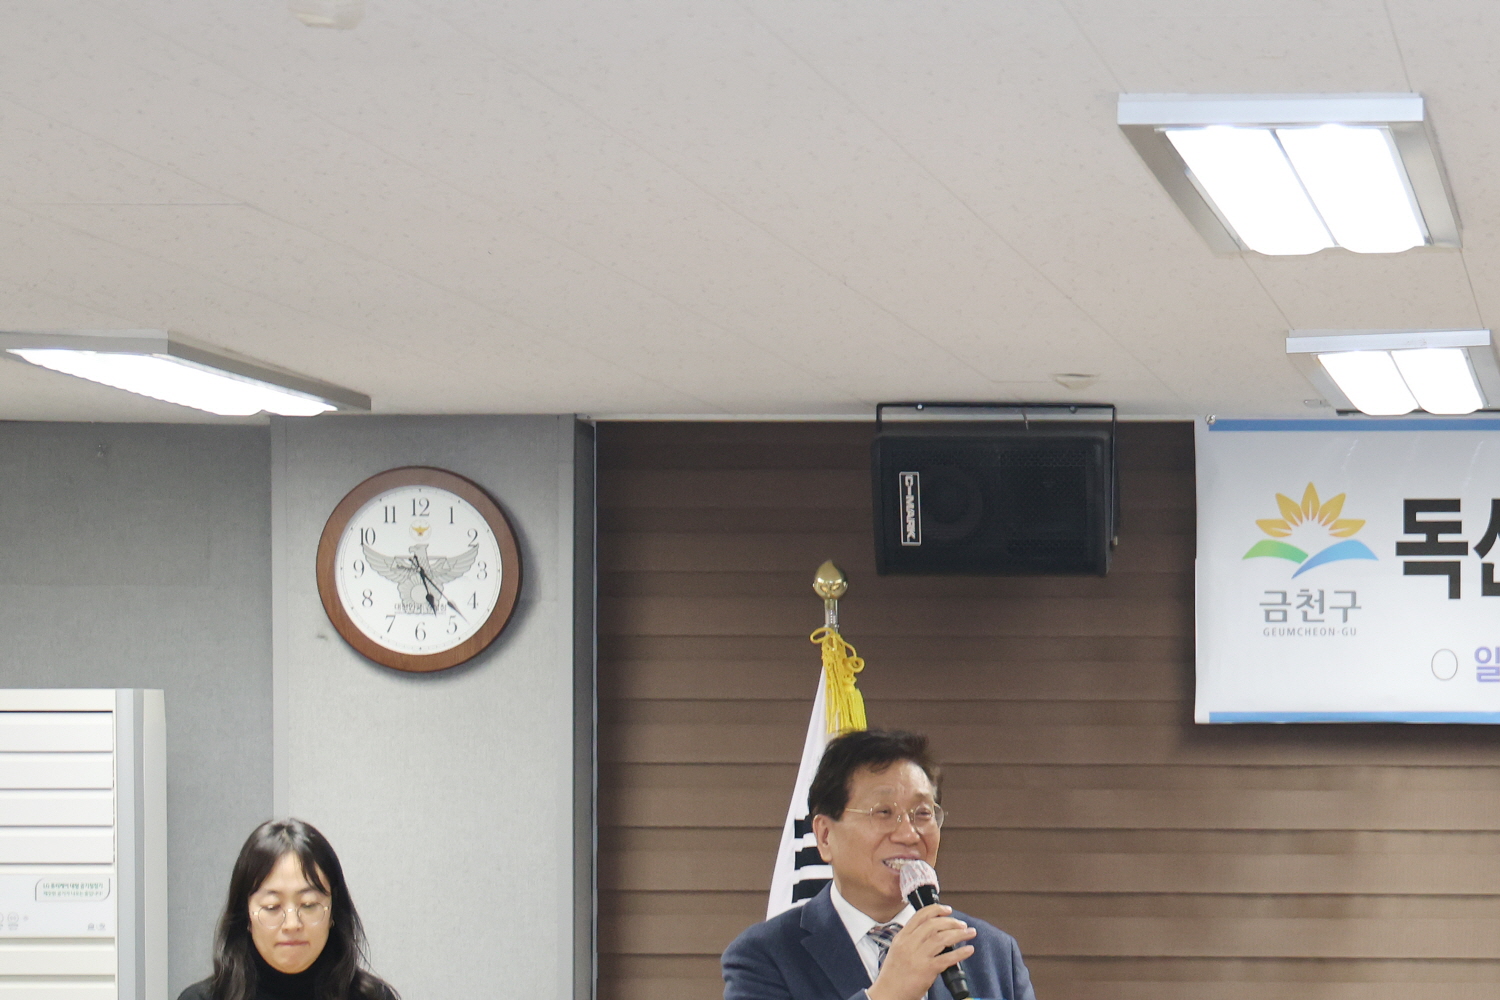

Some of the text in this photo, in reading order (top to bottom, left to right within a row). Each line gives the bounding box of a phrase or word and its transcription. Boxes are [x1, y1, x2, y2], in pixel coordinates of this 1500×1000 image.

[383, 505, 397, 524] 11
[411, 498, 430, 517] 12
[448, 506, 454, 525] 1
[359, 527, 376, 546] 10
[467, 528, 479, 548] 2
[353, 559, 365, 579] 9
[476, 561, 488, 580] 3
[361, 589, 374, 608] 8
[467, 591, 478, 609] 4
[1258, 588, 1362, 624] 금천구
[385, 615, 396, 633] 7
[414, 622, 426, 641] 6
[446, 615, 458, 634] 5
[1262, 627, 1357, 637] GEUMCHEON-GU
